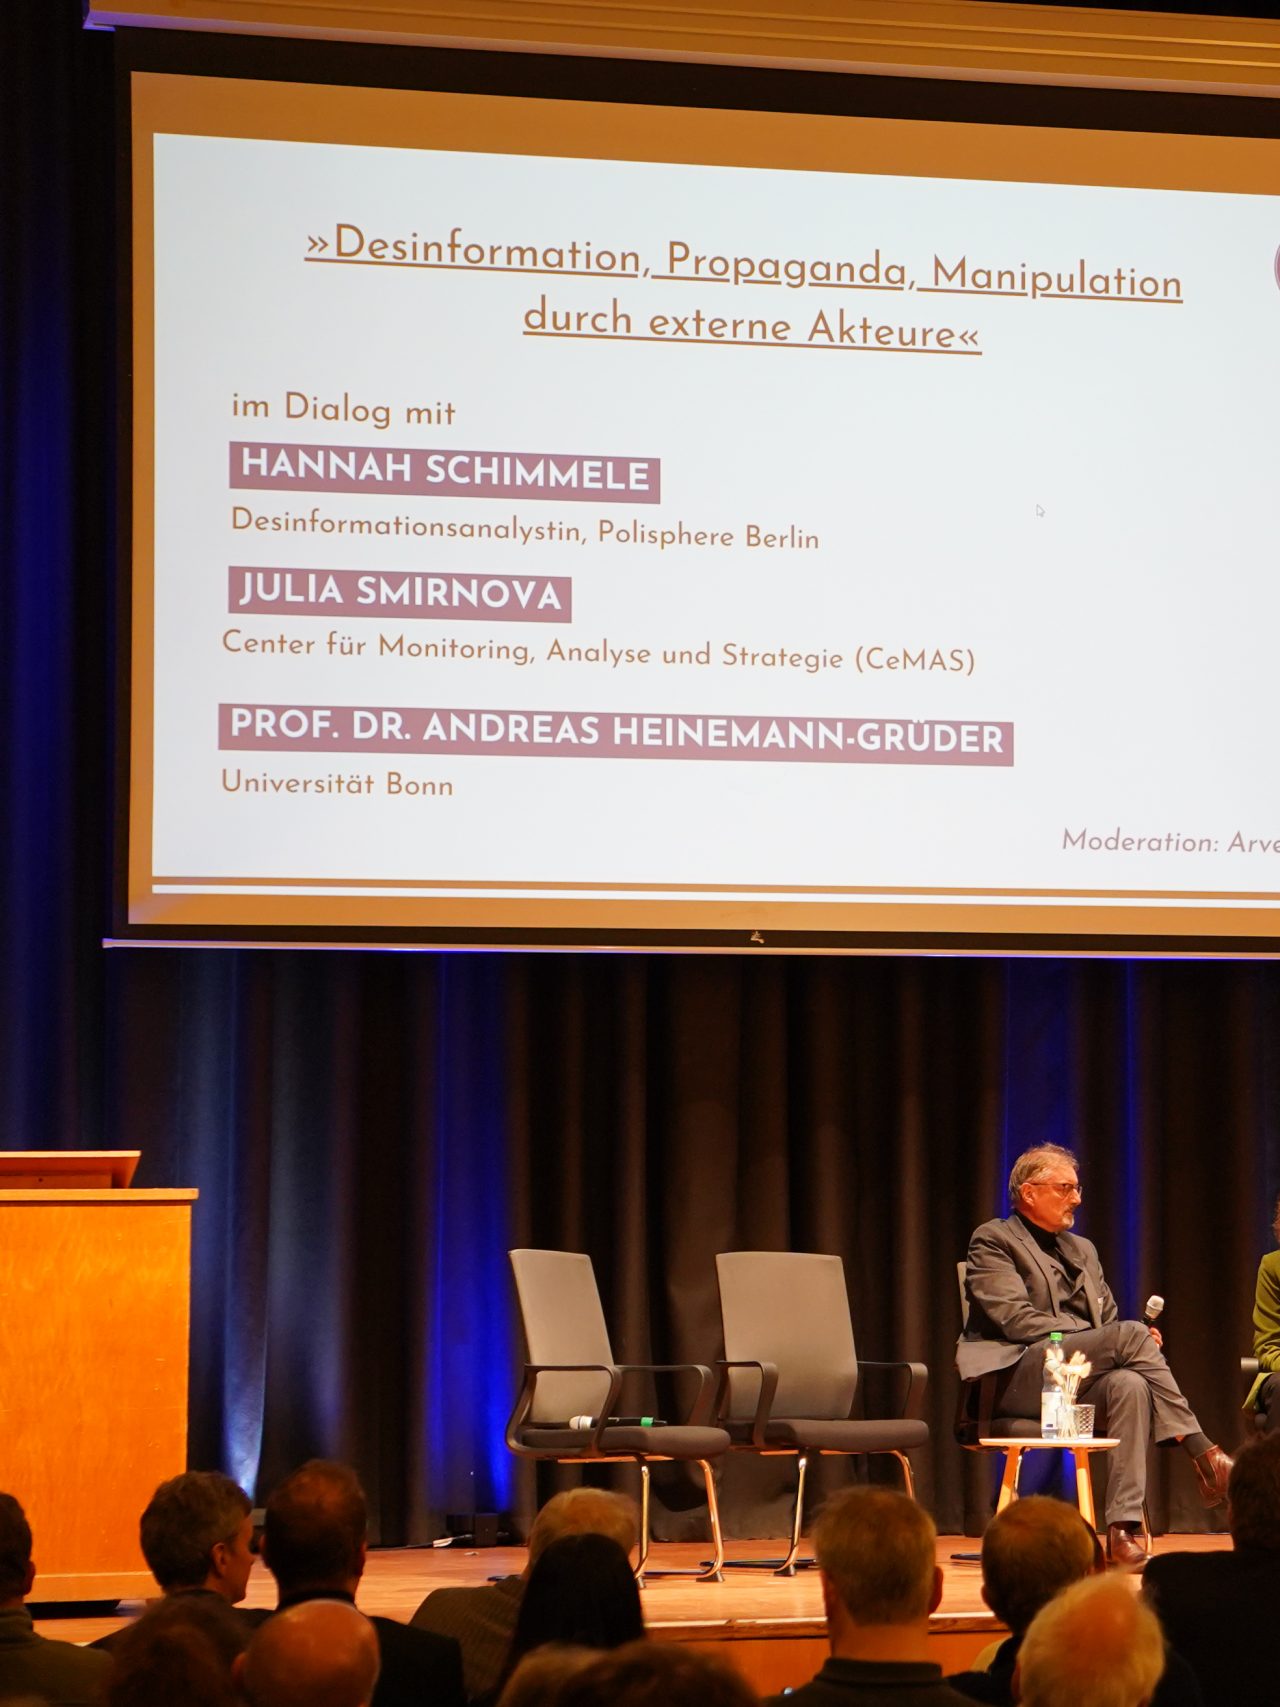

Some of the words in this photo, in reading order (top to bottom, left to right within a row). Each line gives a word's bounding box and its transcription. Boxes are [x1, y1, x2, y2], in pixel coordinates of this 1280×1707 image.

[306, 222, 651, 278] »Desinformation,
[668, 240, 915, 289] Propaganda,
[933, 252, 1182, 299] Manipulation
[523, 294, 632, 333] durch
[649, 309, 792, 341] externe
[807, 308, 979, 348] Akteure«
[232, 392, 269, 418] im
[285, 390, 391, 430] Dialog
[406, 401, 456, 426] mit
[242, 447, 411, 482] HANNAH
[426, 454, 650, 491] SCHIMMELE
[232, 505, 587, 546] Desinformationsanalystin,
[599, 518, 734, 551] Polisphere
[746, 524, 819, 549] Berlin
[239, 572, 344, 606] JULIA
[356, 575, 562, 610] SMIRNOVA
[222, 628, 316, 655] Center
[326, 630, 367, 656] für
[379, 633, 535, 666] Monitoring,
[546, 637, 651, 669] Analyse
[663, 640, 711, 665] und
[722, 642, 843, 674] Strategie
[855, 645, 975, 677] (CeMAS)
[231, 707, 339, 738] PROF.
[353, 710, 411, 740] DR.
[422, 712, 599, 745] ANDREAS
[613, 716, 1004, 753] HEINEMANN-GRÜDER
[221, 768, 375, 794] Universität
[387, 771, 453, 796] Bonn
[1062, 826, 1219, 852] Moderation:
